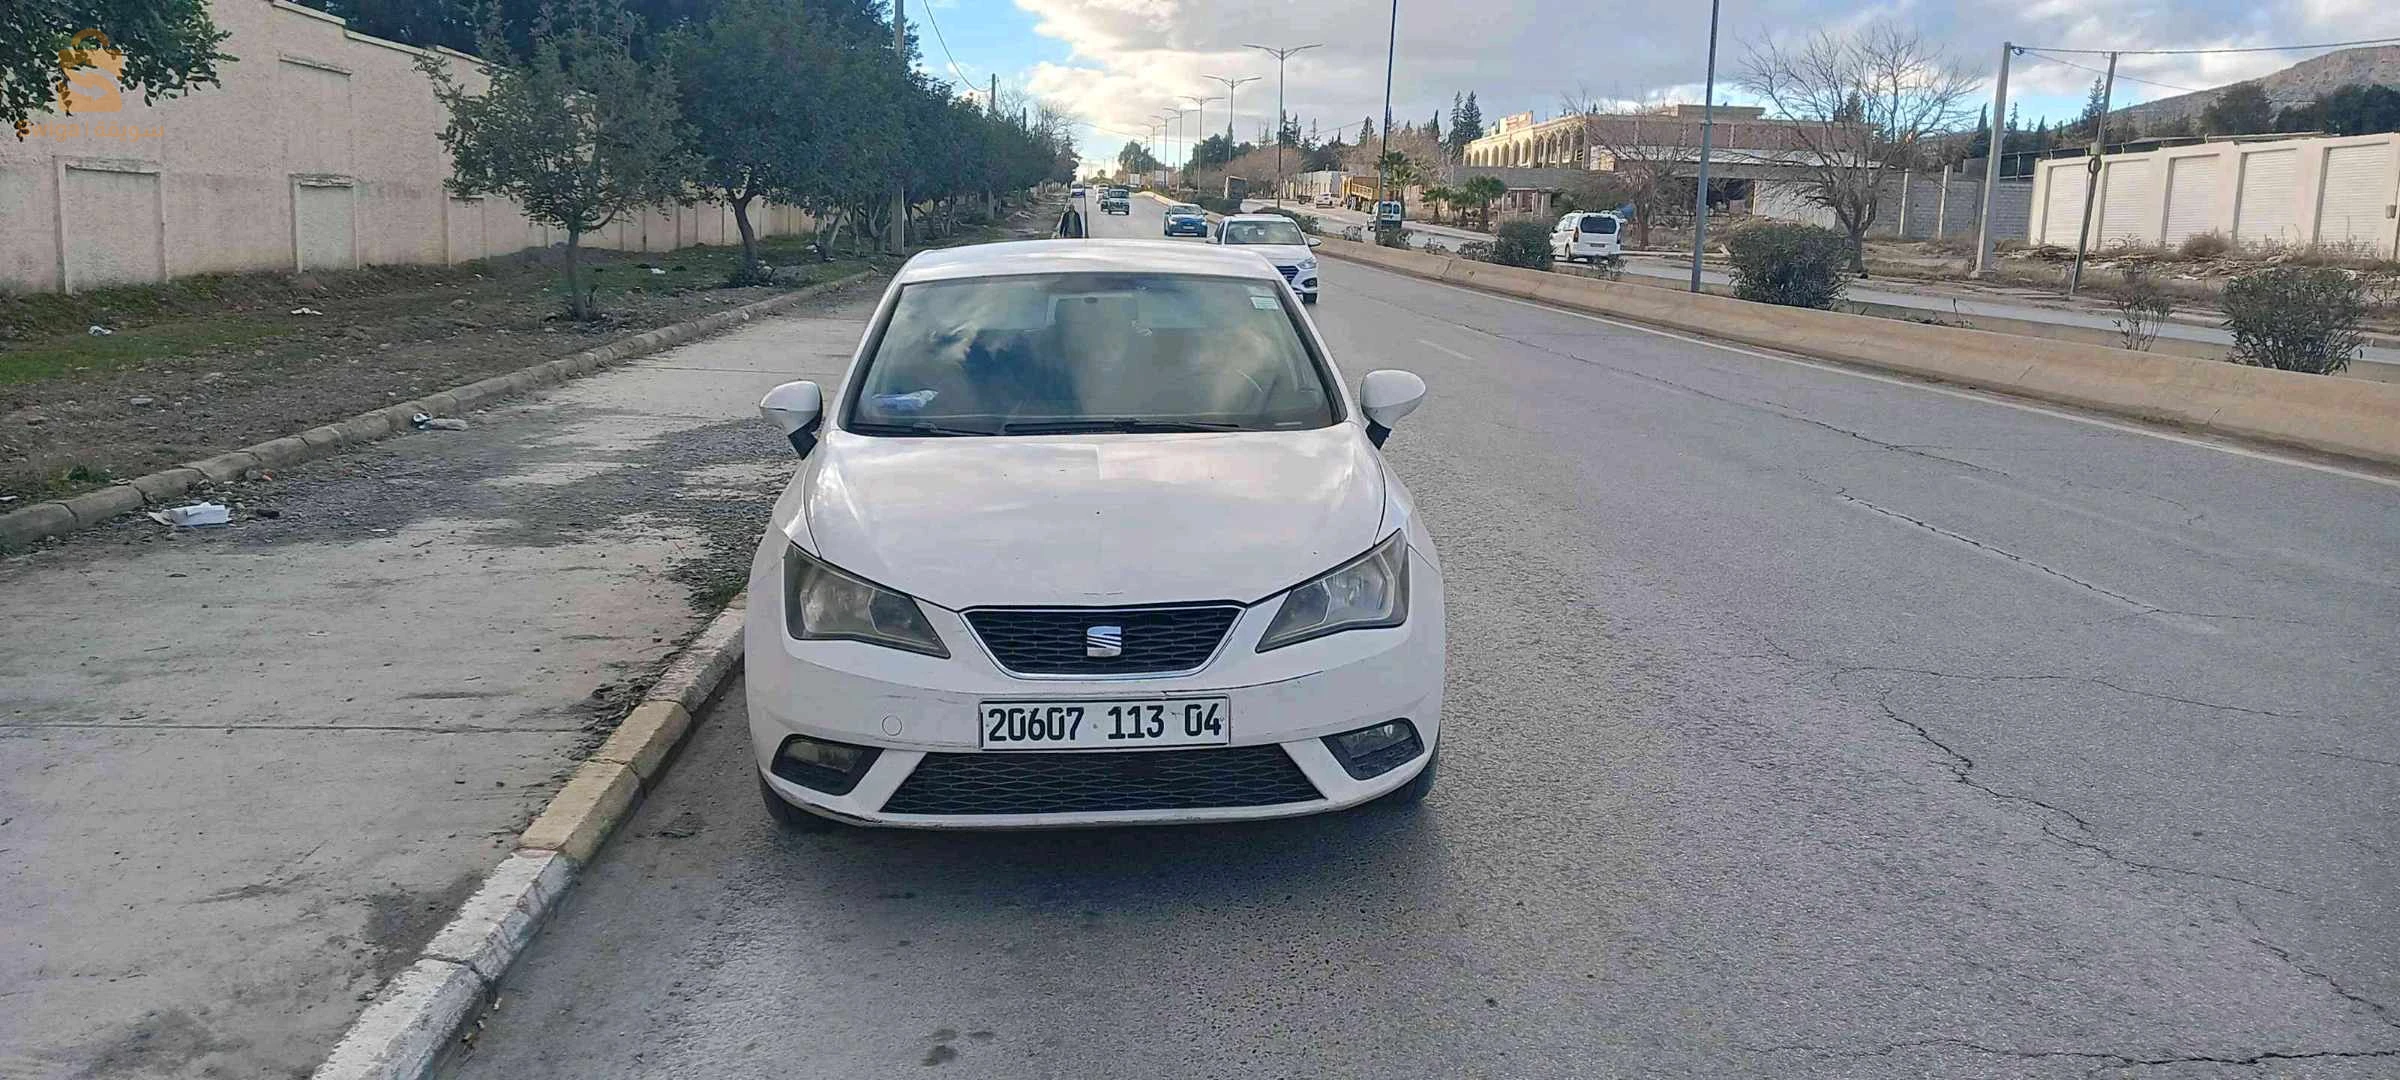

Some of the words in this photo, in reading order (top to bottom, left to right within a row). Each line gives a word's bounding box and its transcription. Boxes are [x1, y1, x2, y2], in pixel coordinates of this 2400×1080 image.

[988, 706, 1084, 741] 20607
[1107, 705, 1165, 740] 113
[1184, 703, 1221, 736] 04
